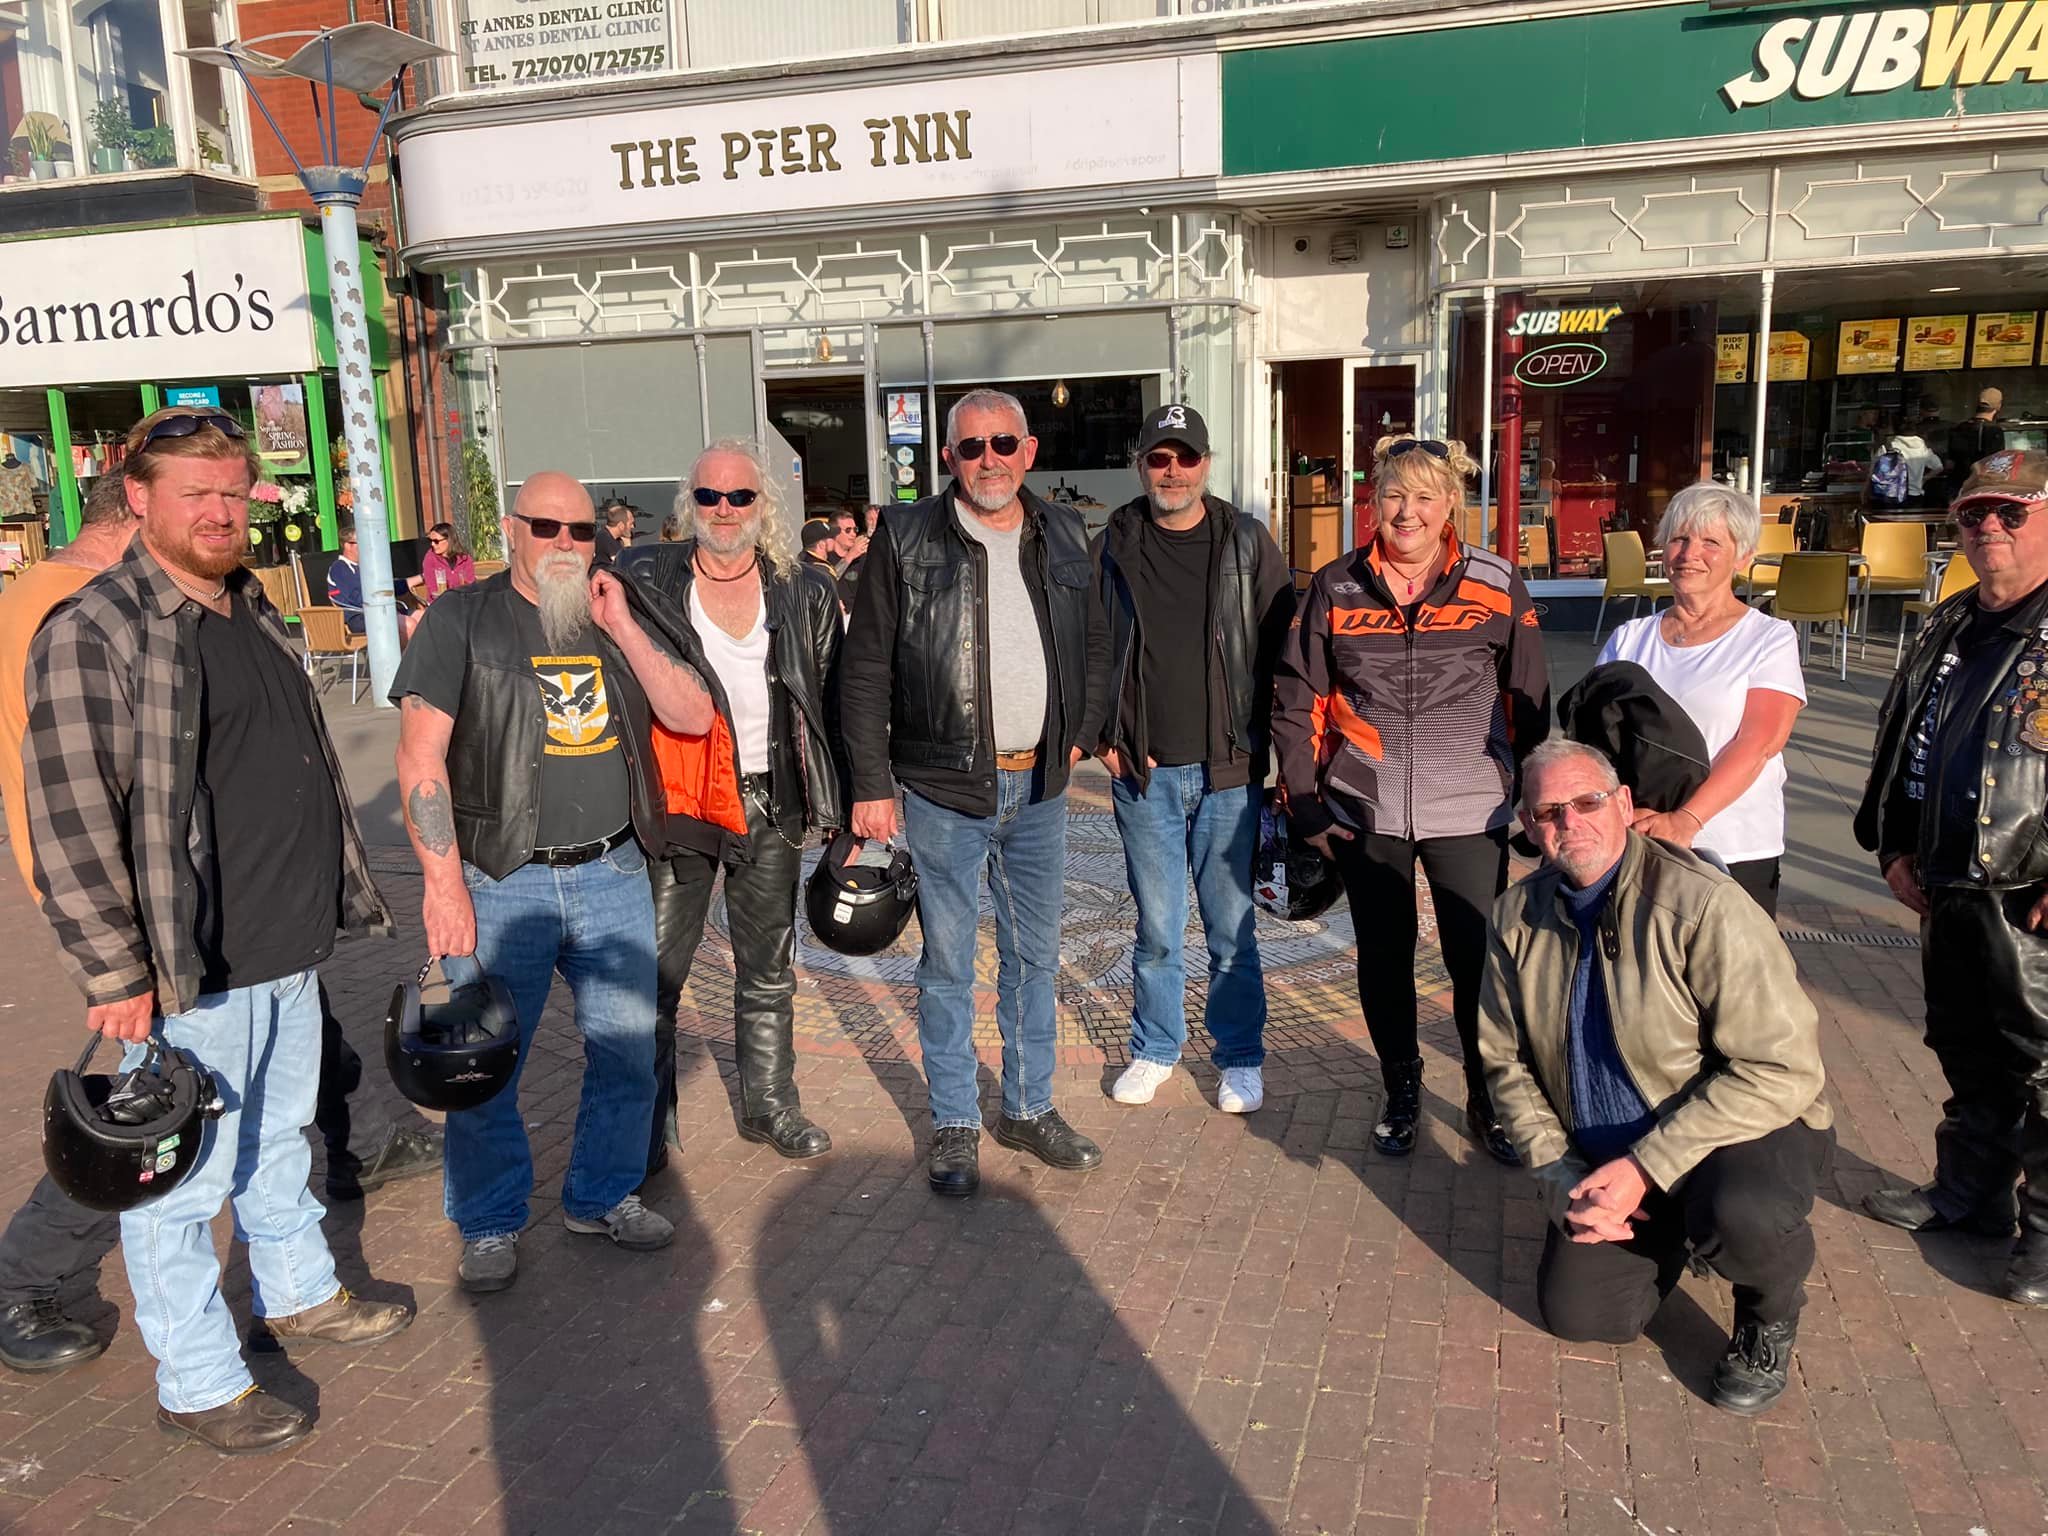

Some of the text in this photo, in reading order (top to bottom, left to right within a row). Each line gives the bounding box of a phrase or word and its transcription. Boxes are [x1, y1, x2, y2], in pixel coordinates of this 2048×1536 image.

[461, 0, 664, 36] ST ANNES DENTAL CLINIC
[465, 44, 665, 84] TEL. 727070/727575
[610, 109, 973, 190] THE PIER INN
[1507, 302, 1624, 336] SUBWAY
[1723, 343, 1742, 352] PAK
[1526, 353, 1594, 376] OPEN
[268, 431, 296, 441] SPRING
[272, 439, 305, 450] FASHION
